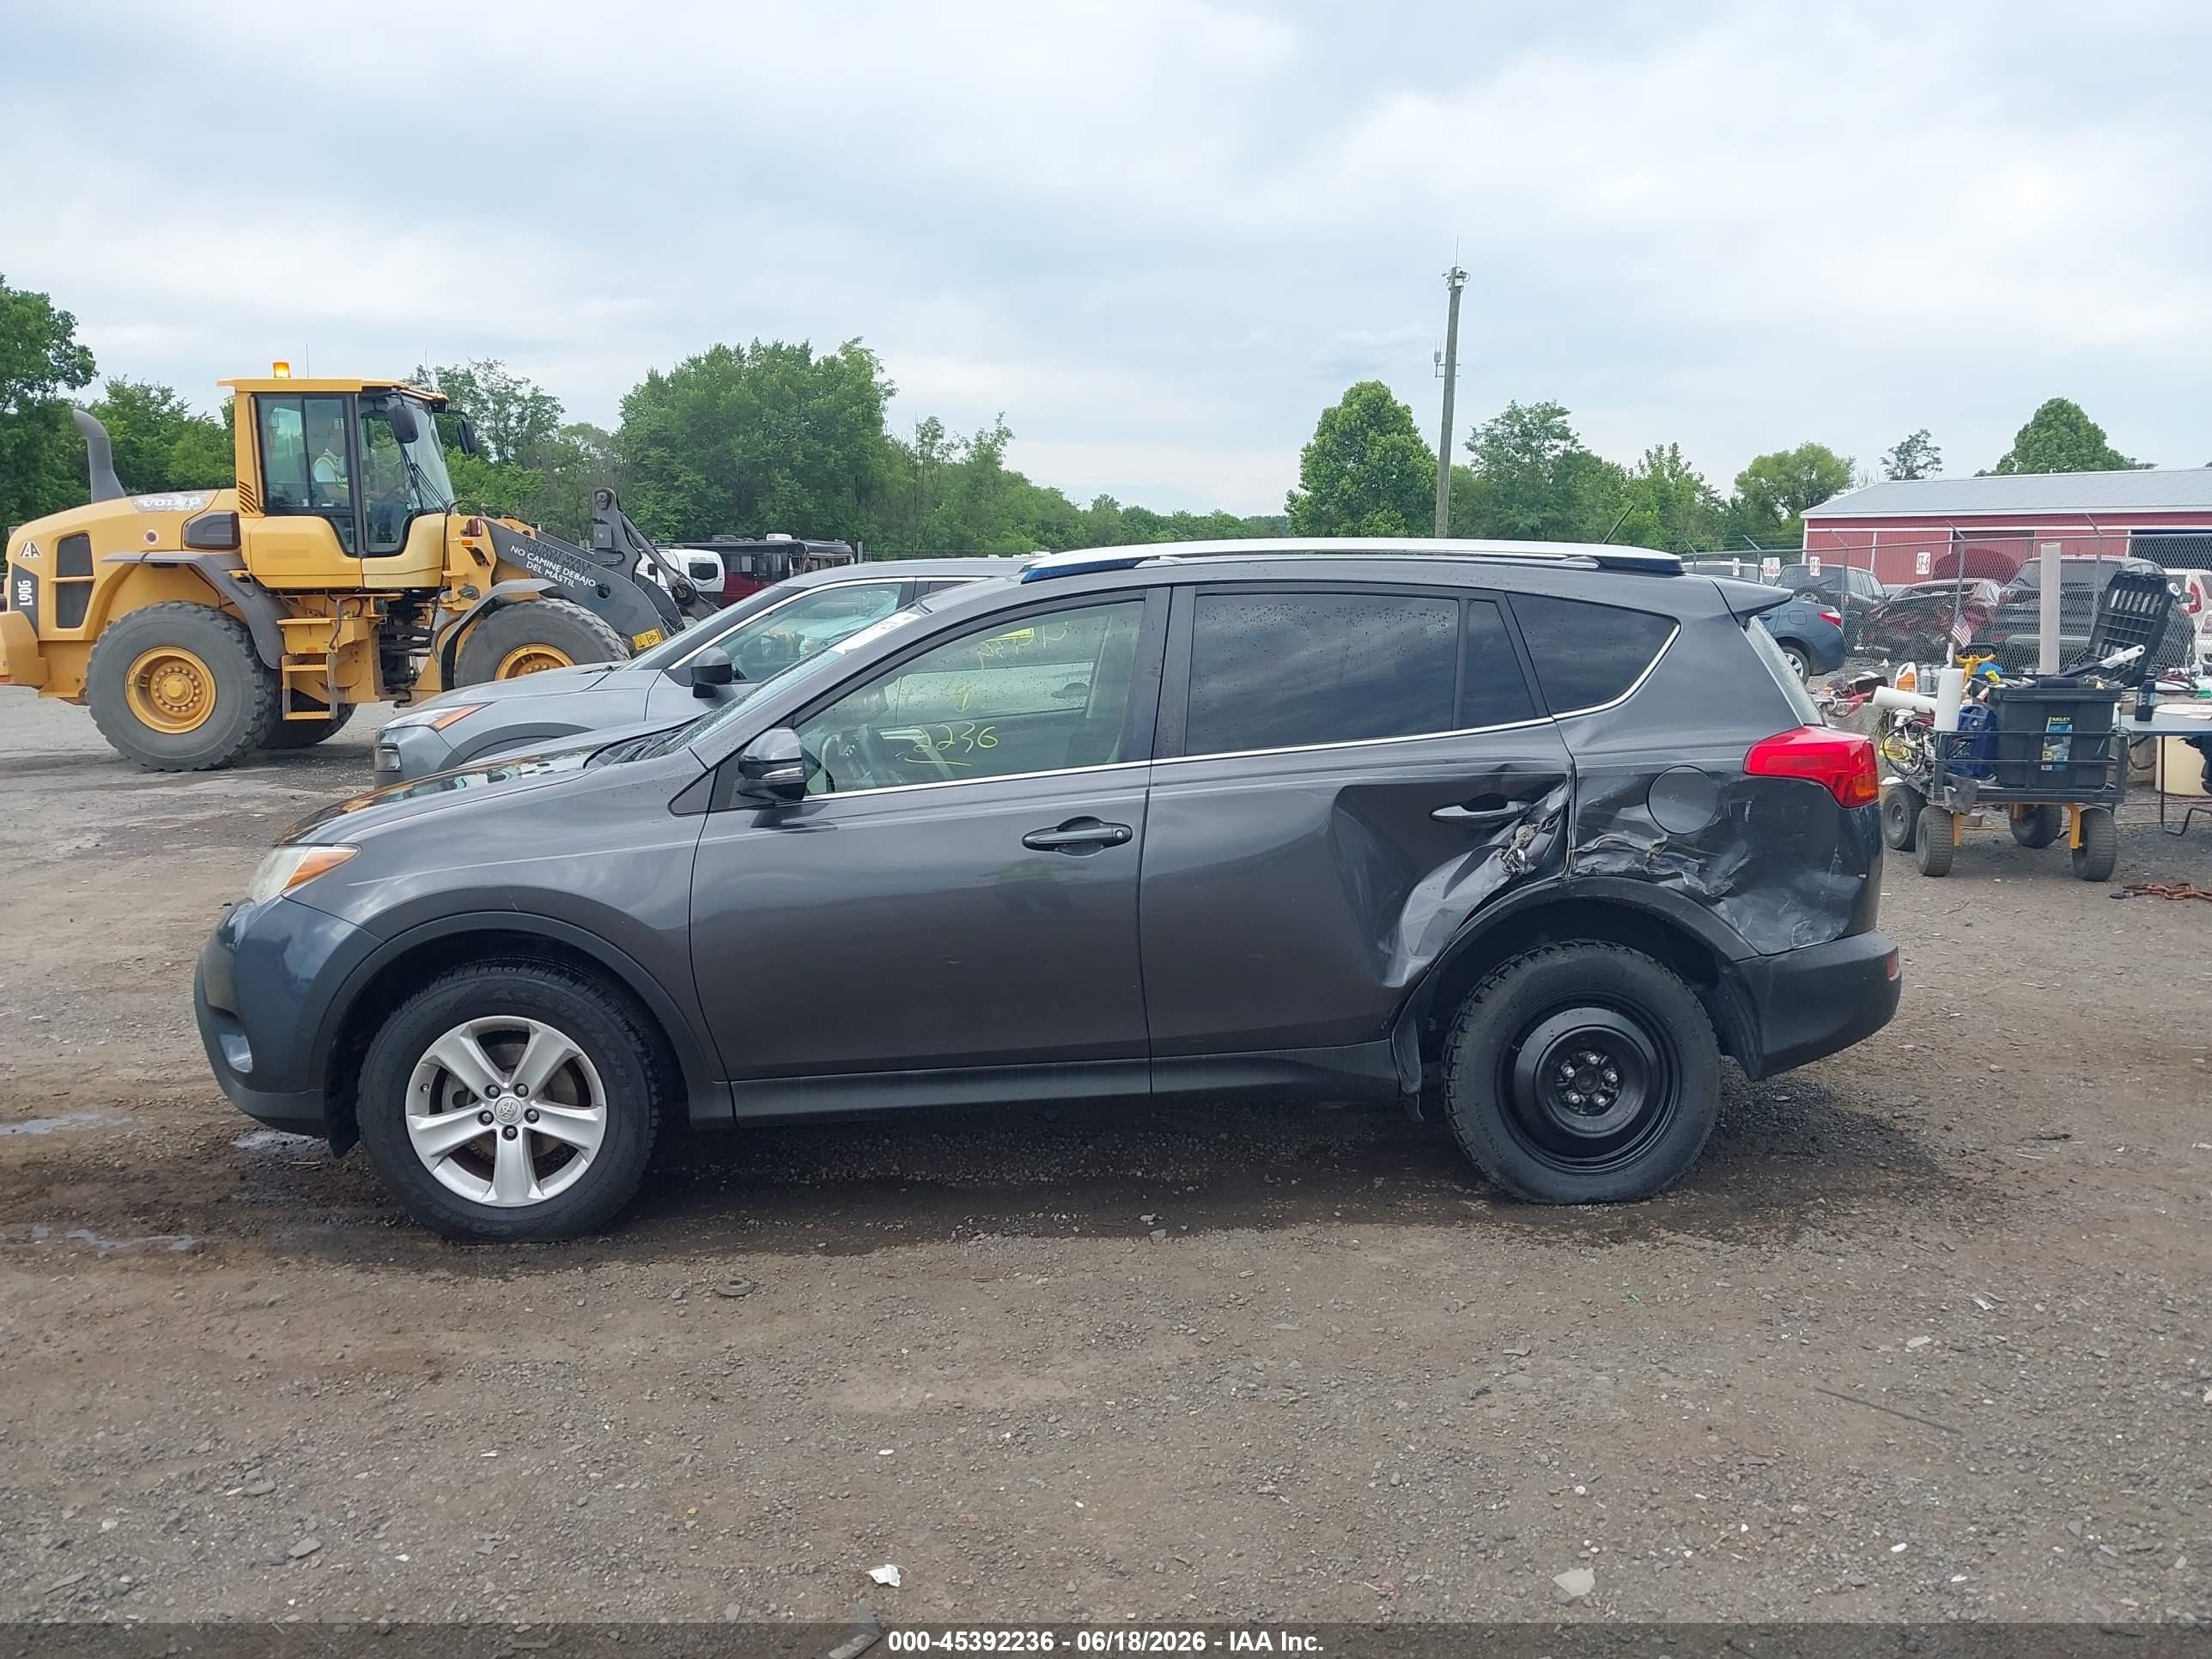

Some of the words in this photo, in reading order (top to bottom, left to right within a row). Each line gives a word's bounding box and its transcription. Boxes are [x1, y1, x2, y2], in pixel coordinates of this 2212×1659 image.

[510, 544, 526, 556] NO
[526, 552, 562, 573] CAMINE
[562, 568, 596, 587] DEBAJO
[526, 561, 543, 574] DEL
[17, 580, 33, 606] L90G
[907, 721, 999, 754] 2236
